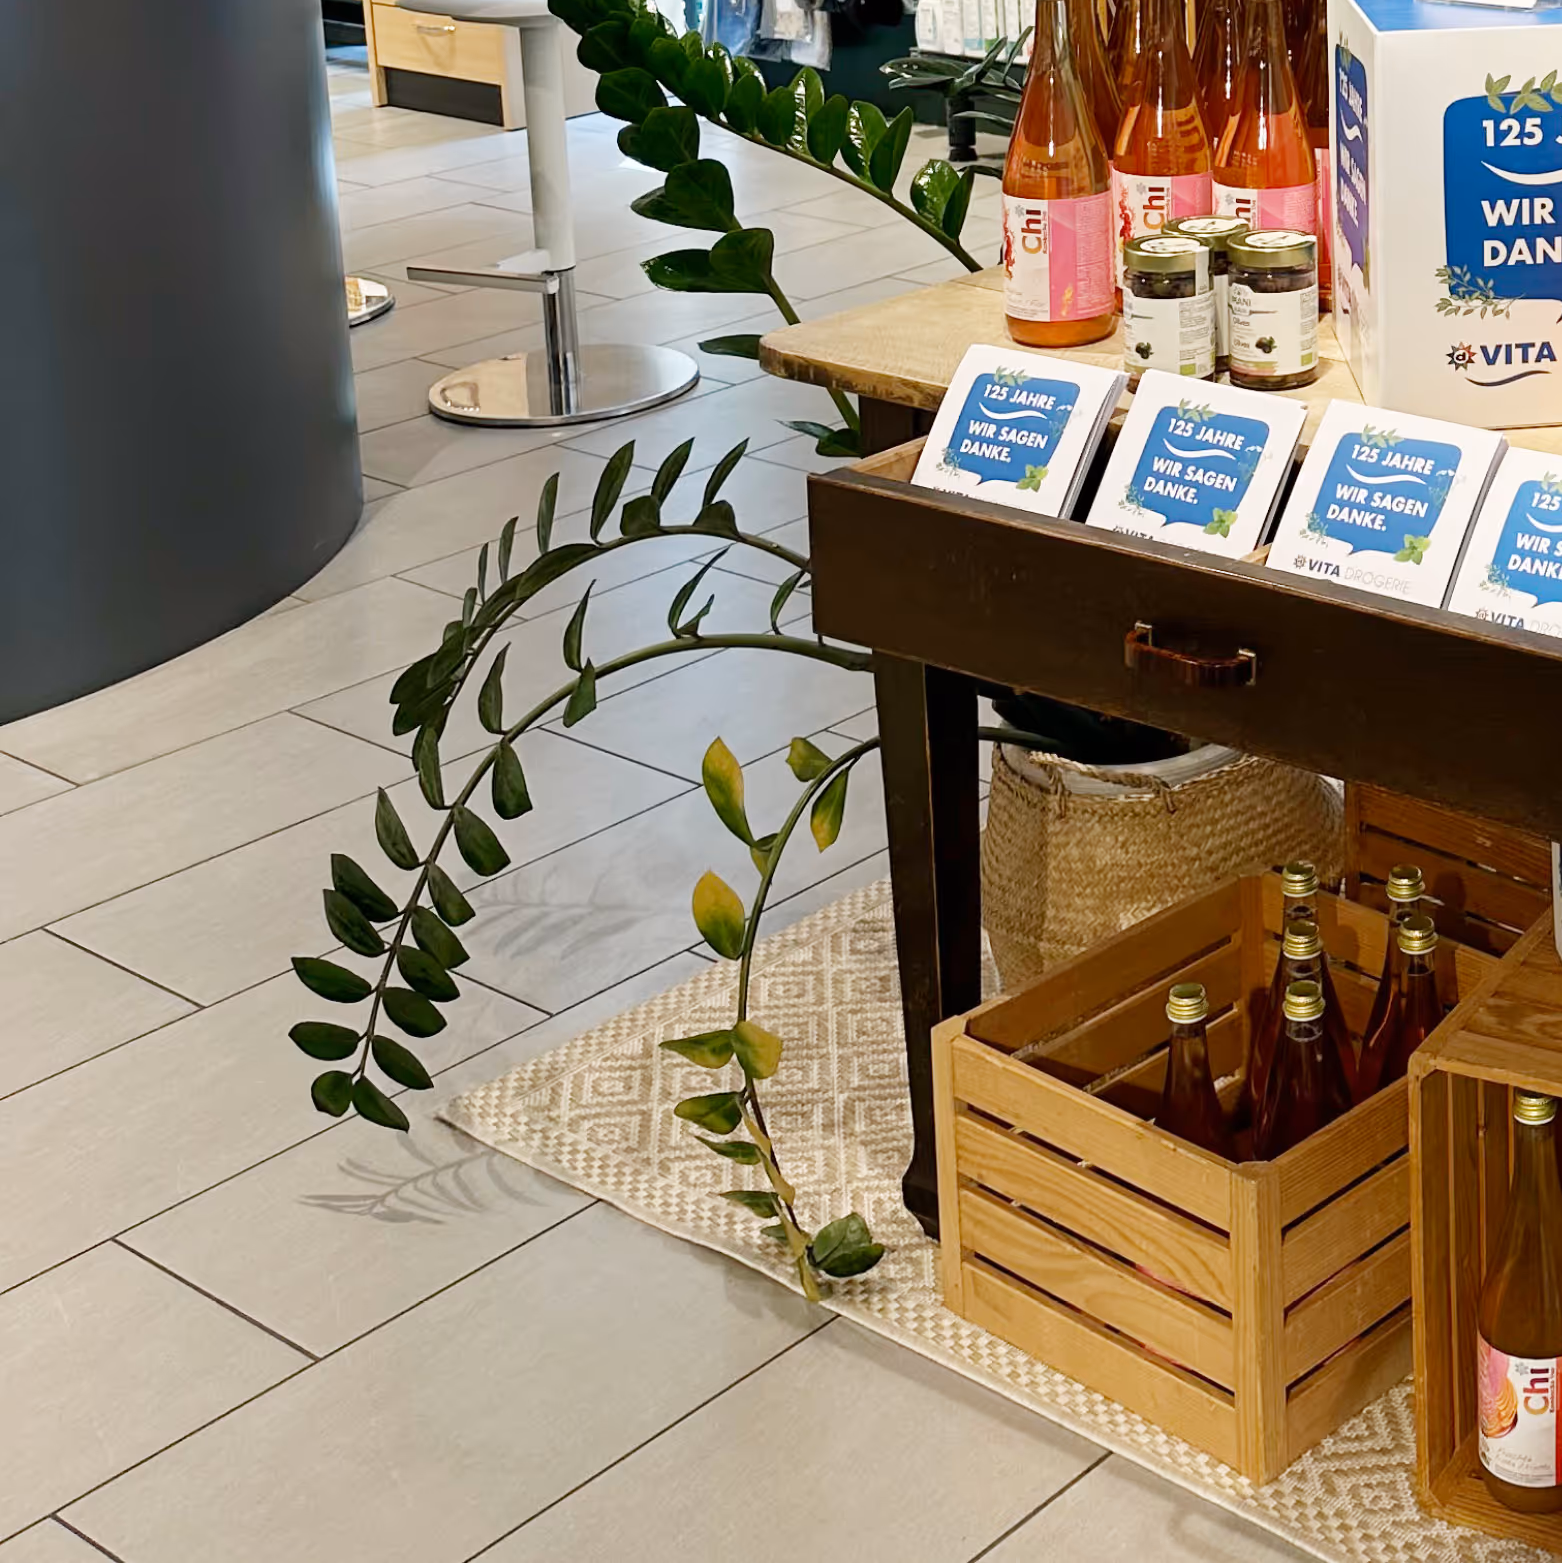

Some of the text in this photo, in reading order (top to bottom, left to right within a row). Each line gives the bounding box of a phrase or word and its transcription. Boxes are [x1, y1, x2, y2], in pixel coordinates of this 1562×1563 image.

[1482, 116, 1544, 148] 125
[1143, 186, 1166, 230] Chi
[1481, 198, 1555, 228] WIR
[1021, 209, 1042, 254] Chi
[1480, 341, 1558, 367] VITA
[982, 383, 1057, 411] 125 JAHRE
[968, 419, 1049, 450] WIR SAGEN
[1167, 417, 1245, 453] 125 JAHRE
[959, 441, 1012, 464] DANKE.
[1351, 444, 1436, 476] 125 JAHRE
[1151, 456, 1238, 492] WIR SAGEN
[1143, 476, 1199, 506] DANKE.
[1335, 483, 1430, 518] WIR SAGEN
[1530, 492, 1562, 513] 125
[1326, 503, 1388, 533] DANKE.
[1515, 532, 1551, 554] WIR
[1307, 559, 1411, 596] VITA DROGERIE
[1489, 611, 1526, 631] VITA
[1523, 1367, 1550, 1416] Chi
